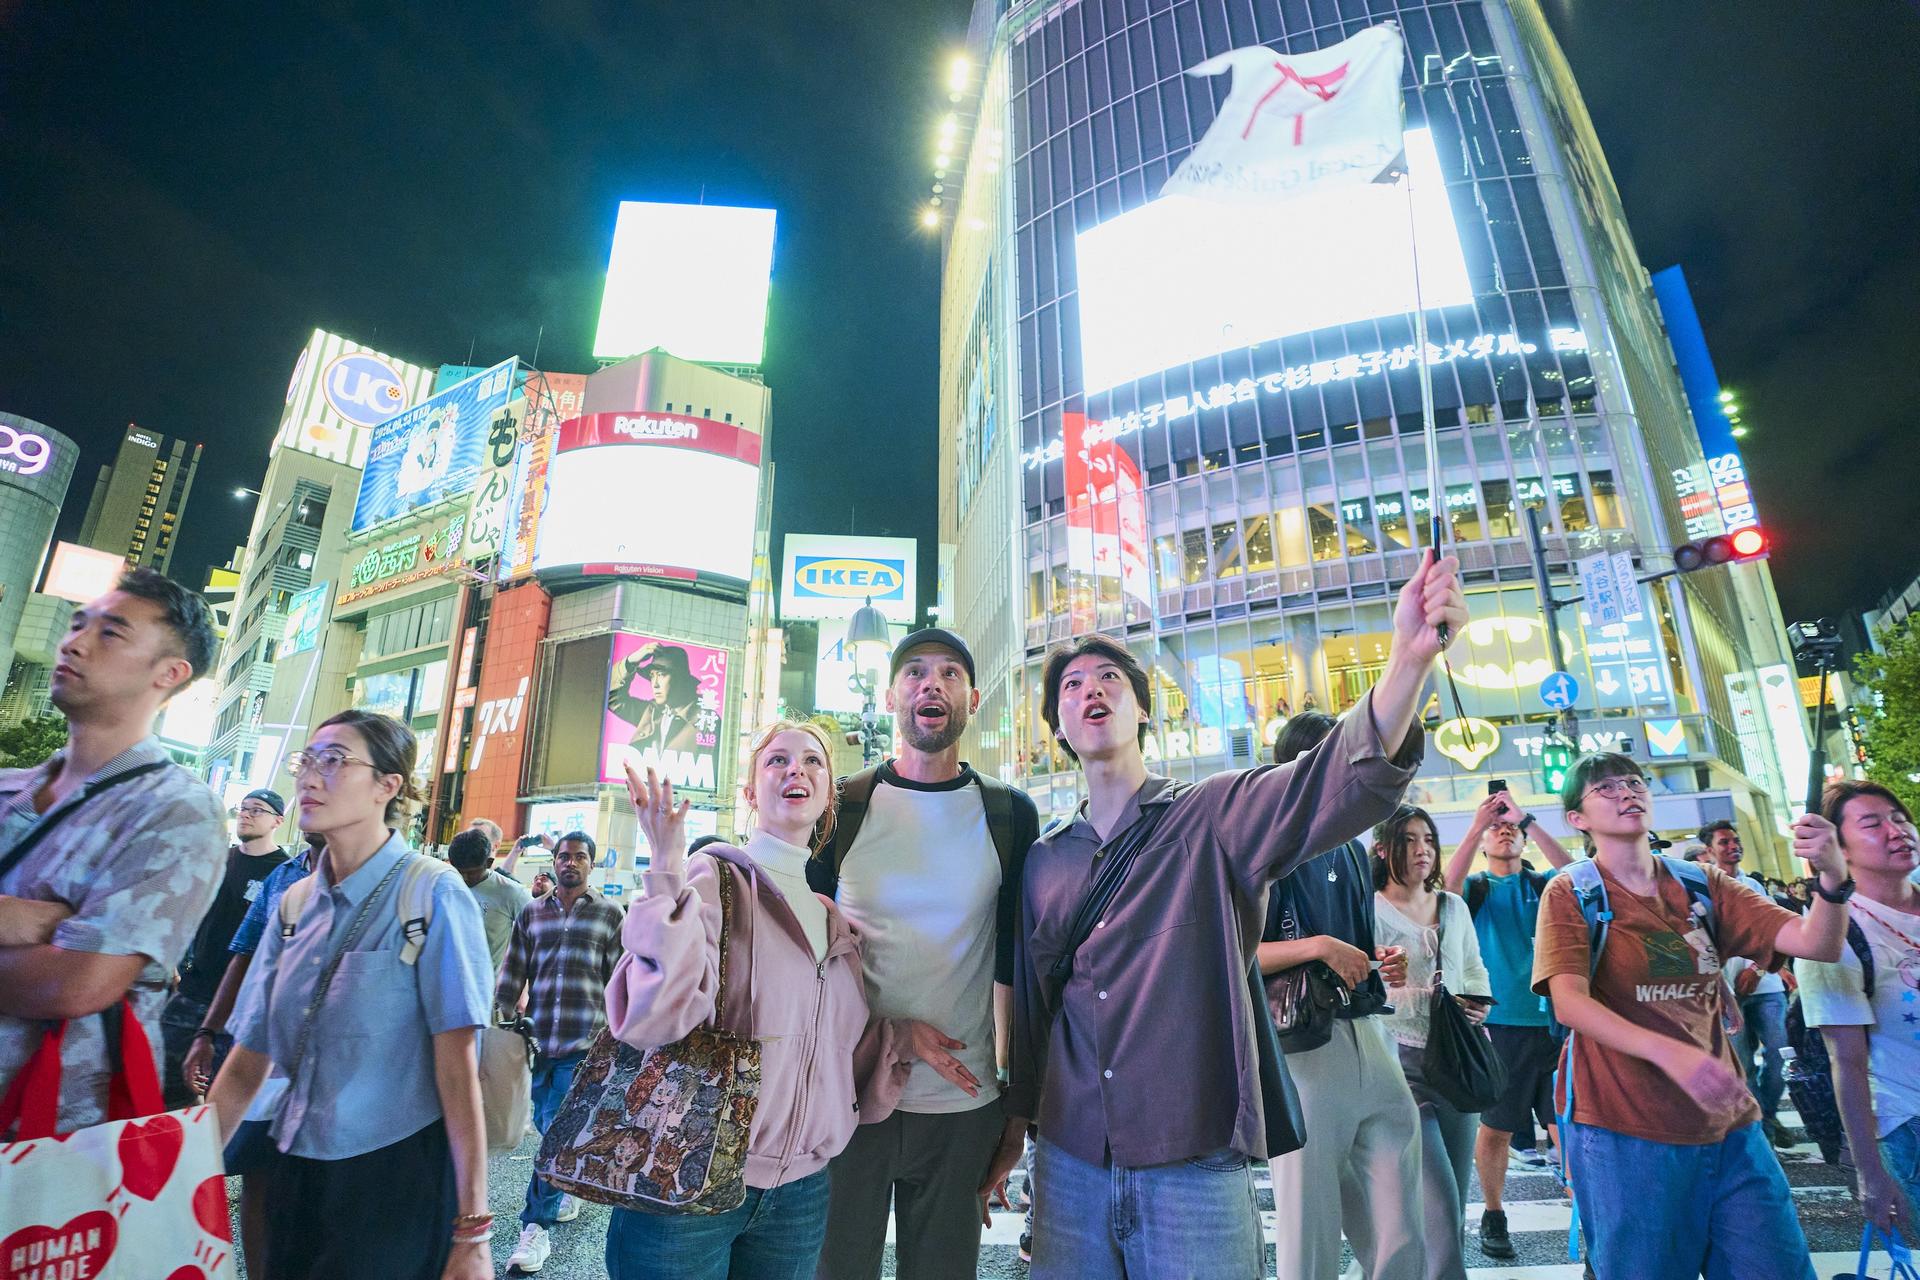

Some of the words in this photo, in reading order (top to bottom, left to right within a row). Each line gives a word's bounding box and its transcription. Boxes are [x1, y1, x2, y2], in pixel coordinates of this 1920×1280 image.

[613, 416, 698, 440] Rakuten
[128, 435, 157, 449] INDIGO
[614, 564, 642, 575] Rakuten
[643, 566, 664, 575] Vision
[807, 569, 894, 586] IKEA
[1591, 558, 1618, 622] 渋谷駅前
[695, 733, 716, 744] 9.18
[1512, 731, 1631, 757] TSAY
[1635, 983, 1700, 1002] WHALE
[10, 1226, 102, 1272] HUMAN
